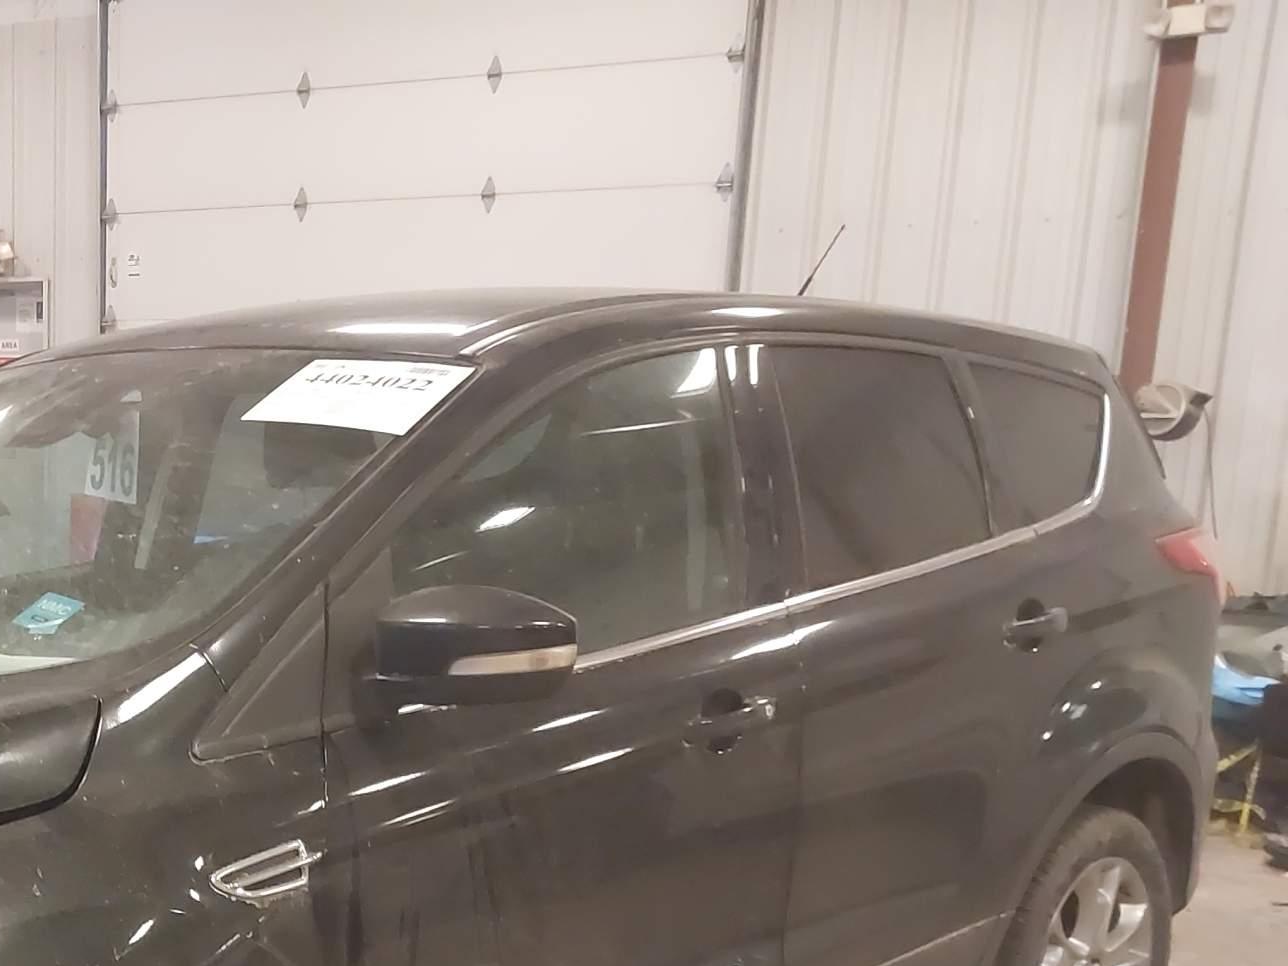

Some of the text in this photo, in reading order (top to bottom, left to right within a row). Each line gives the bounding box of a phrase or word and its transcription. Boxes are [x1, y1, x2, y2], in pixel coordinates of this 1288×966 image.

[1, 341, 18, 350] AREA
[305, 371, 434, 392] 44024022
[90, 440, 135, 497] 516
